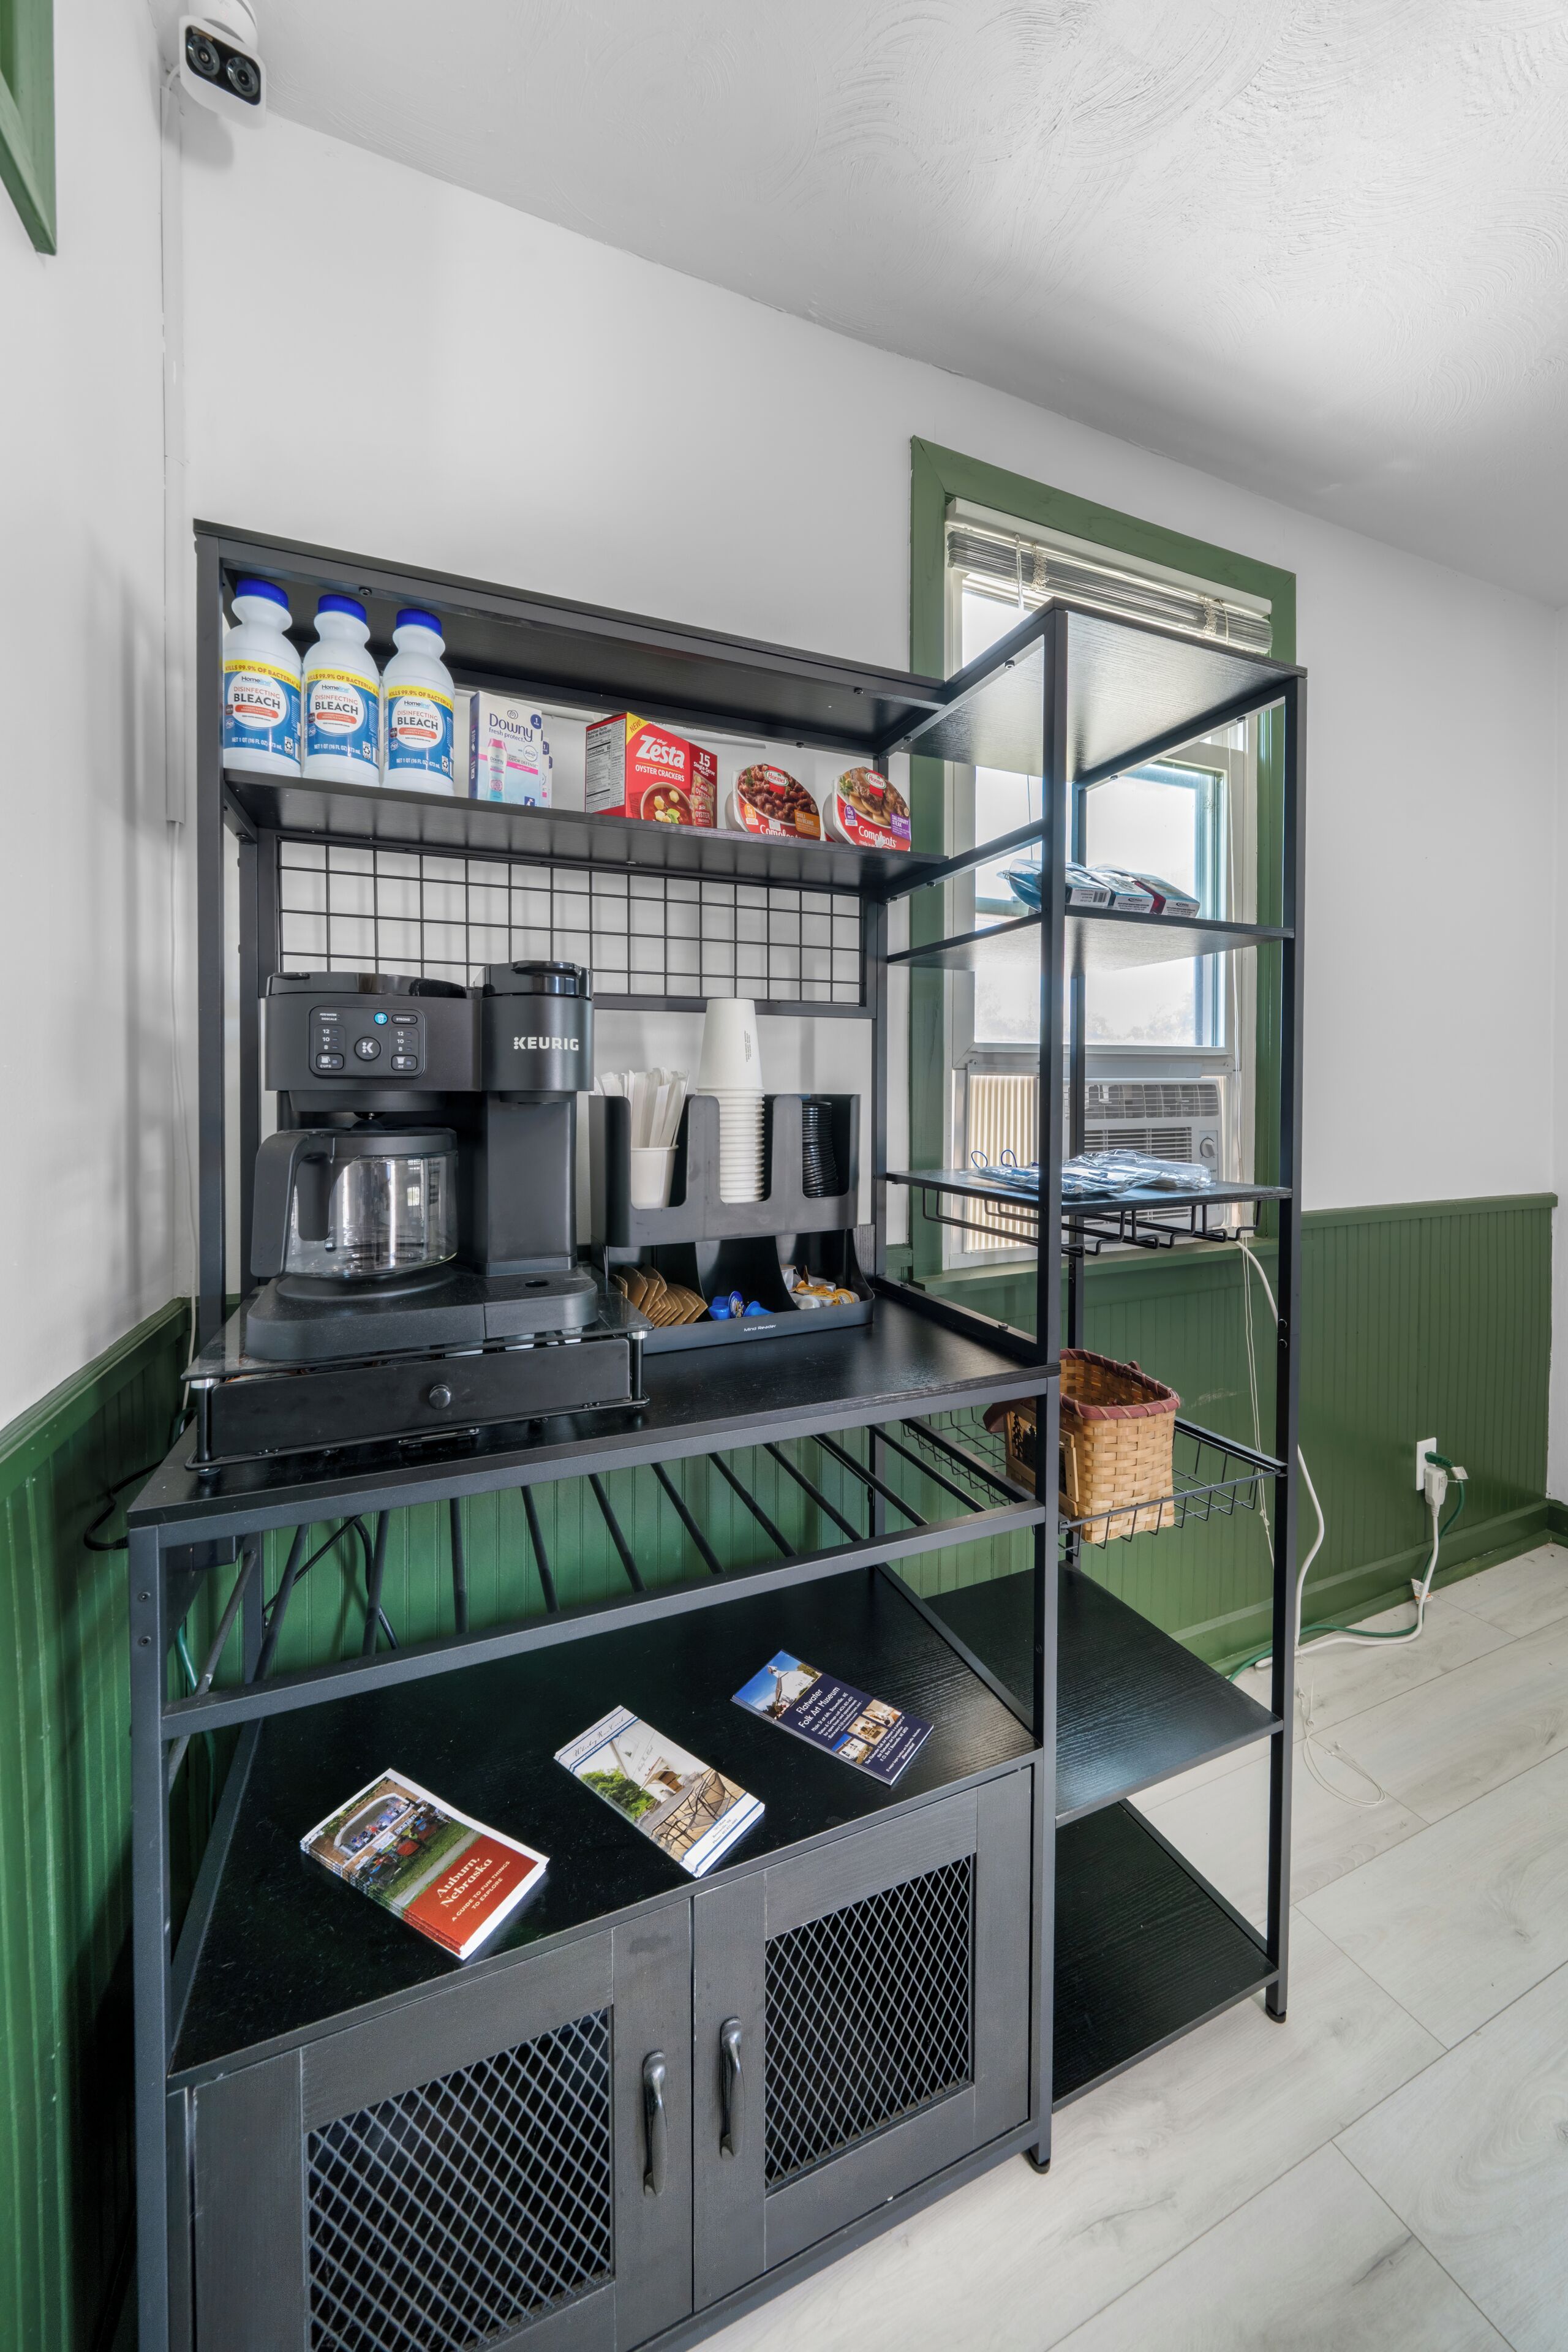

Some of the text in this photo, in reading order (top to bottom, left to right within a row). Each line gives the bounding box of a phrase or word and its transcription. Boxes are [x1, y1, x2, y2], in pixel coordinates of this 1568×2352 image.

[234, 687, 280, 699] DISINFECTING
[315, 695, 358, 706] DISINFECTING
[234, 693, 280, 709] BLEACH
[315, 701, 358, 715] BLEACH
[397, 710, 438, 720] DISINFECTING
[397, 717, 438, 730] BLEACH
[490, 713, 533, 742] Downy
[630, 719, 641, 733] NEW!
[489, 727, 503, 736] fresh
[636, 735, 685, 769] Zesta
[699, 752, 710, 767] 15
[636, 764, 685, 782] OYSTER CRACKERS
[693, 762, 715, 775] Single-Serve
[768, 772, 785, 783] Hormel
[869, 775, 883, 786] Hormel
[513, 1036, 578, 1051] KEURIG
[796, 1689, 823, 1714] Flatwater
[798, 1687, 840, 1728] Folk Art Museum
[437, 1858, 480, 1898] Auburn,
[440, 1859, 492, 1907] Nebraska
[456, 1899, 473, 1916] GUIDE
[481, 1879, 492, 1890] FUN
[491, 1861, 510, 1879] THINGS
[480, 1878, 503, 1901] EXPLORE
